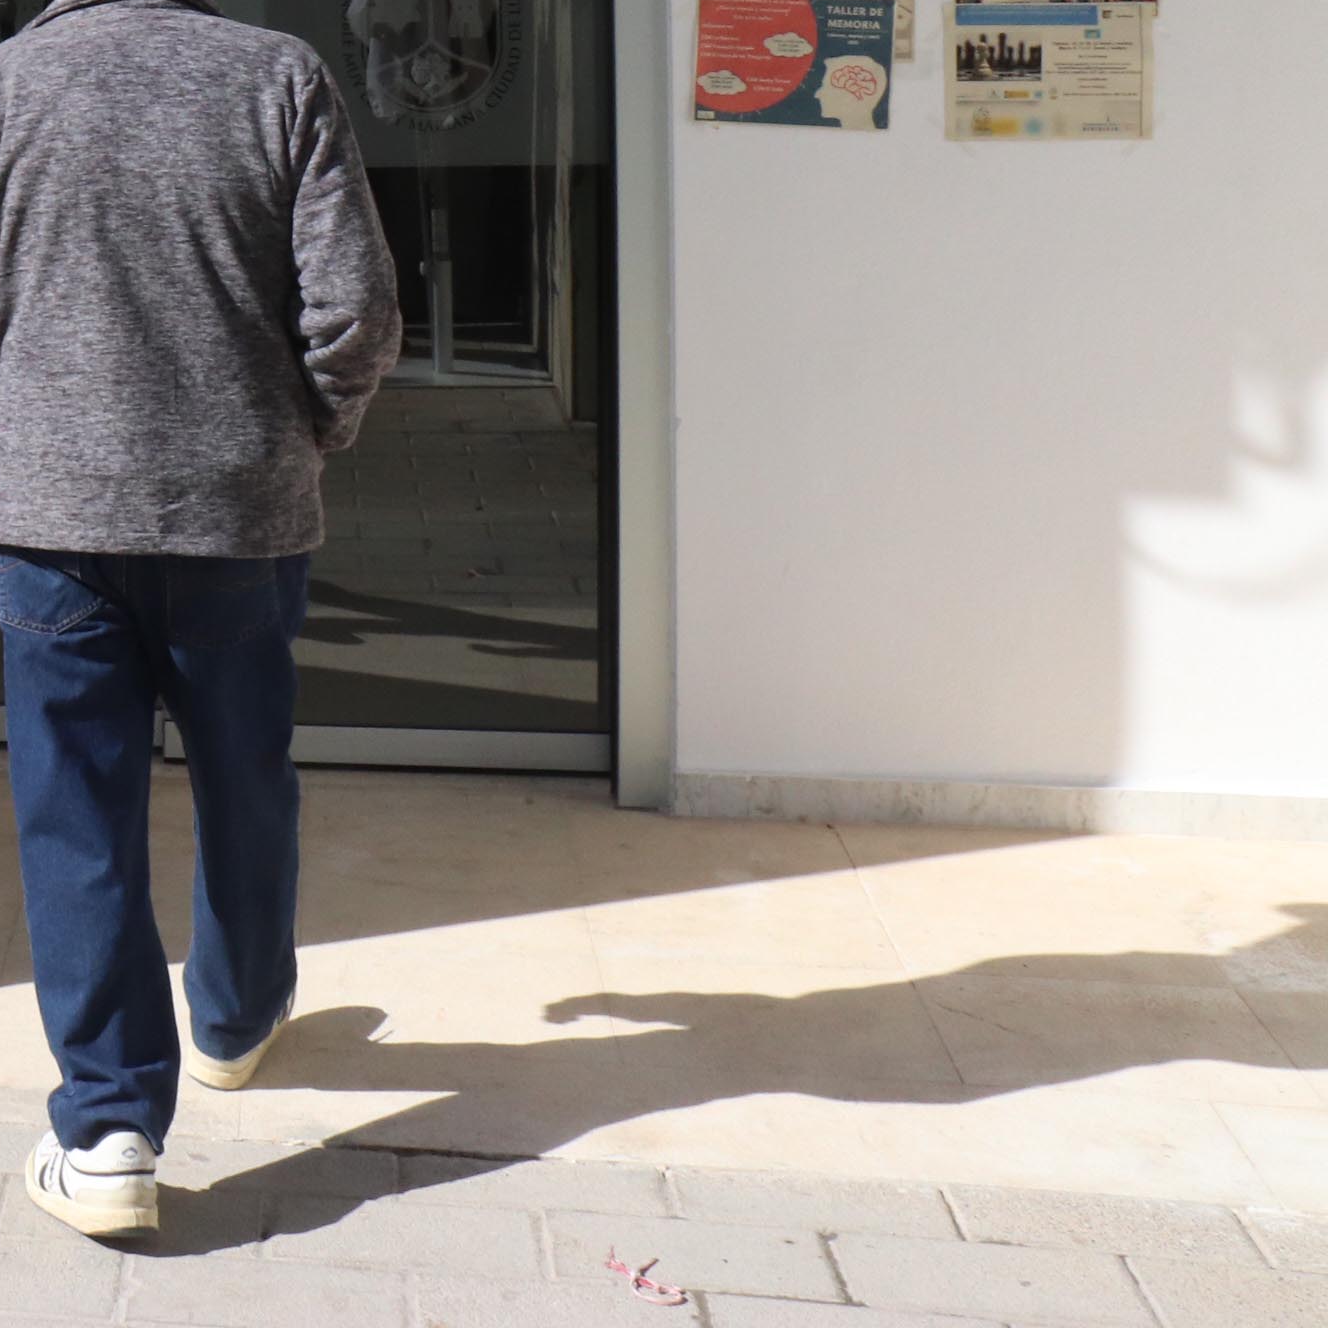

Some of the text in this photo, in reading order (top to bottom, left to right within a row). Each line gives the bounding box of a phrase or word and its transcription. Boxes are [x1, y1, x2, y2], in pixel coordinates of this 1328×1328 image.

[827, 5, 884, 17] TALLER DE
[827, 19, 881, 30] MEMORIA
